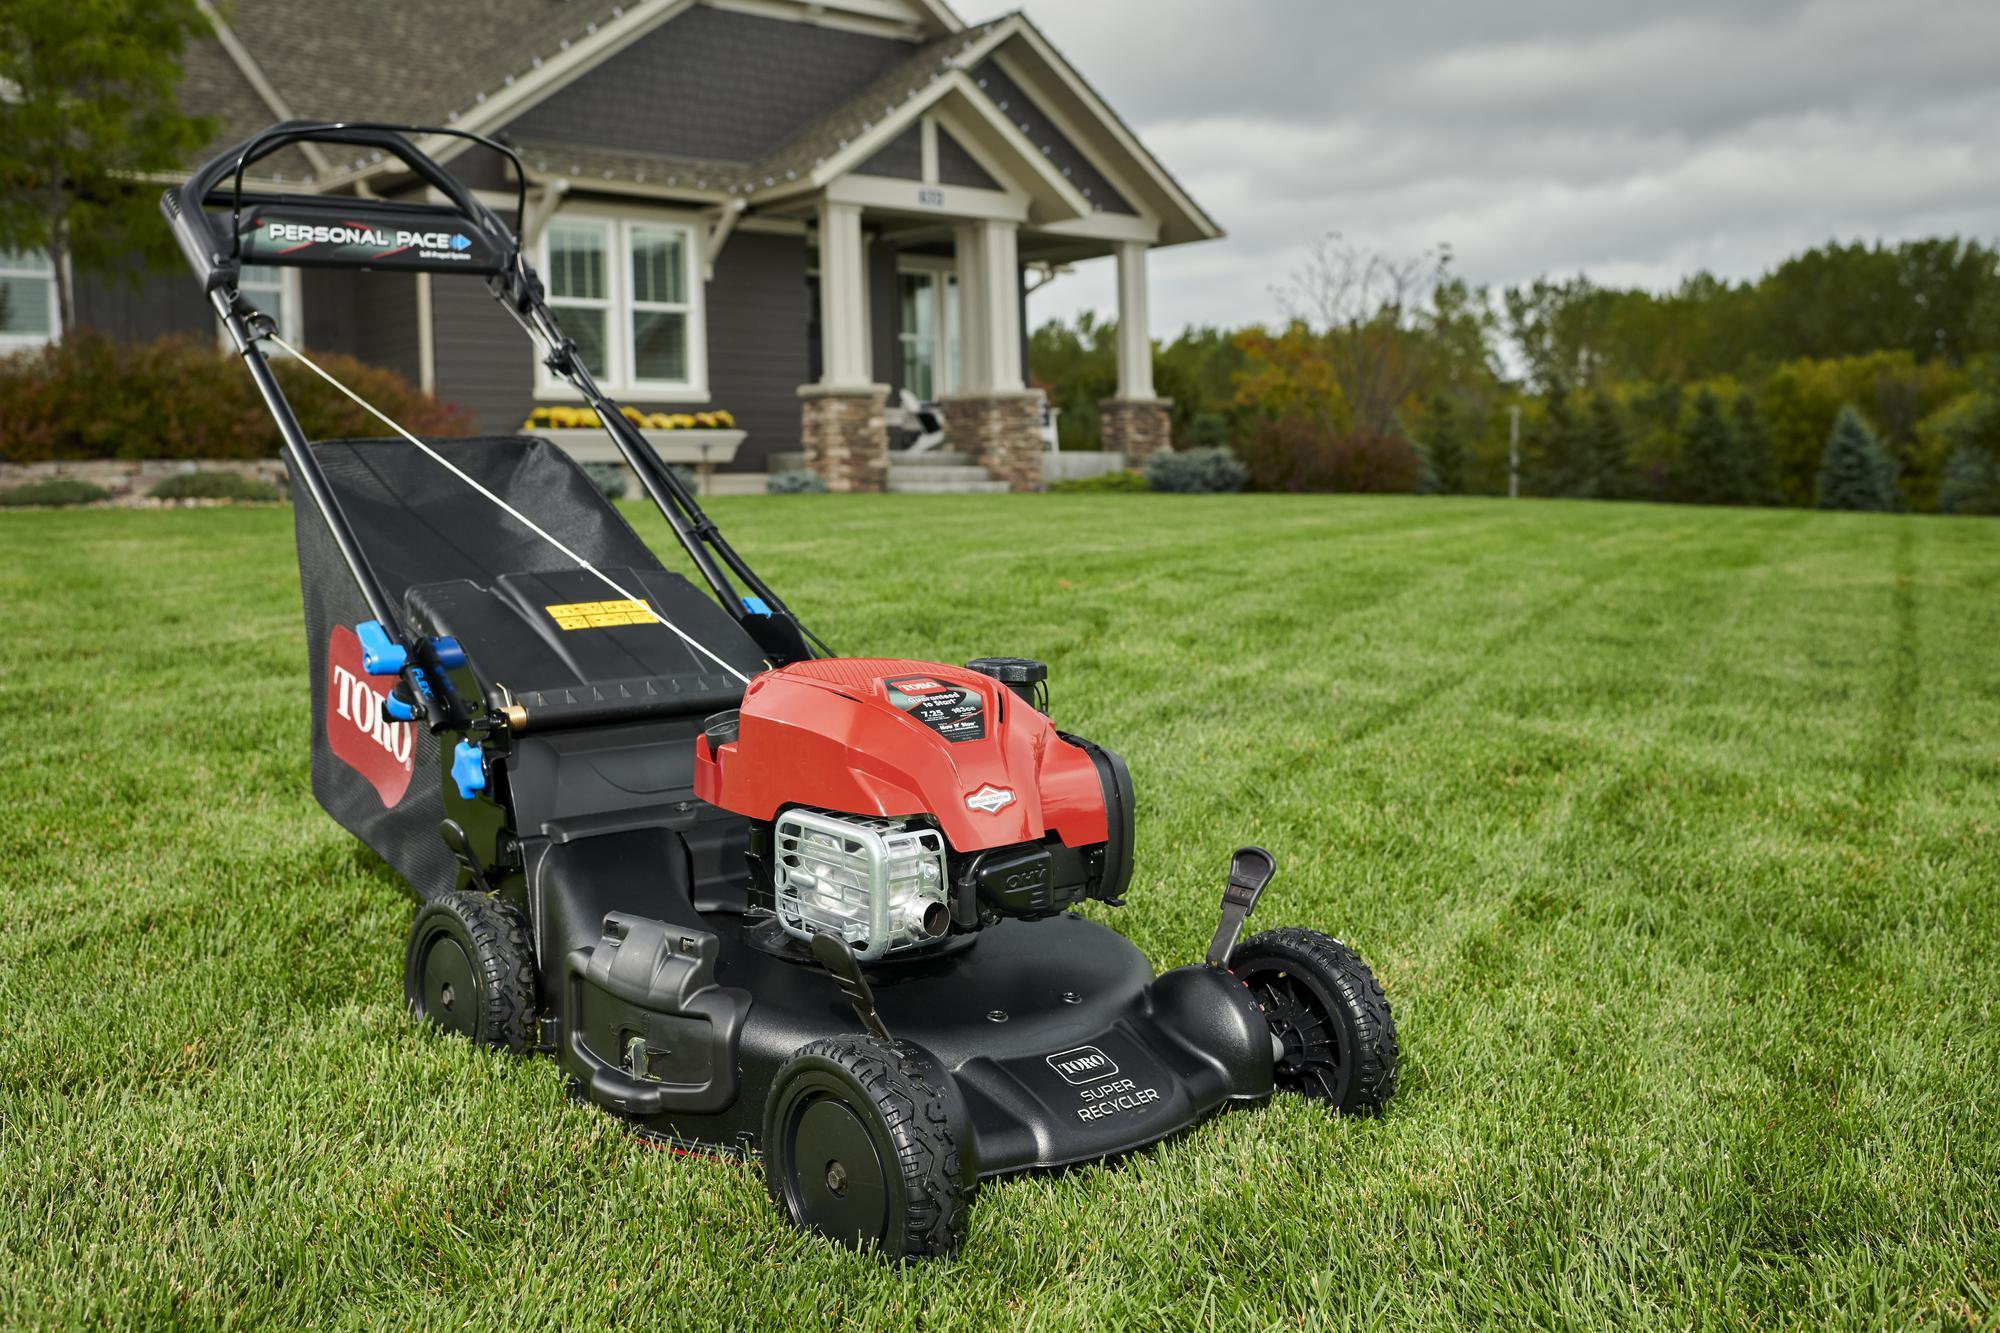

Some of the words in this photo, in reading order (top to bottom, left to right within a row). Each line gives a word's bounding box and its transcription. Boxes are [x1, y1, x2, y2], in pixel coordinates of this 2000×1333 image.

[269, 224, 389, 246] PERSONAL
[396, 231, 450, 249] PACE
[899, 682, 938, 691] TORO
[907, 692, 961, 703] Guaranteed
[934, 698, 955, 707] Start
[333, 665, 412, 763] TORO
[921, 709, 945, 718] 7.25
[1057, 1054, 1105, 1075] TORO
[1080, 1079, 1136, 1102] SUPER
[1077, 1088, 1160, 1122] RECYCLER
